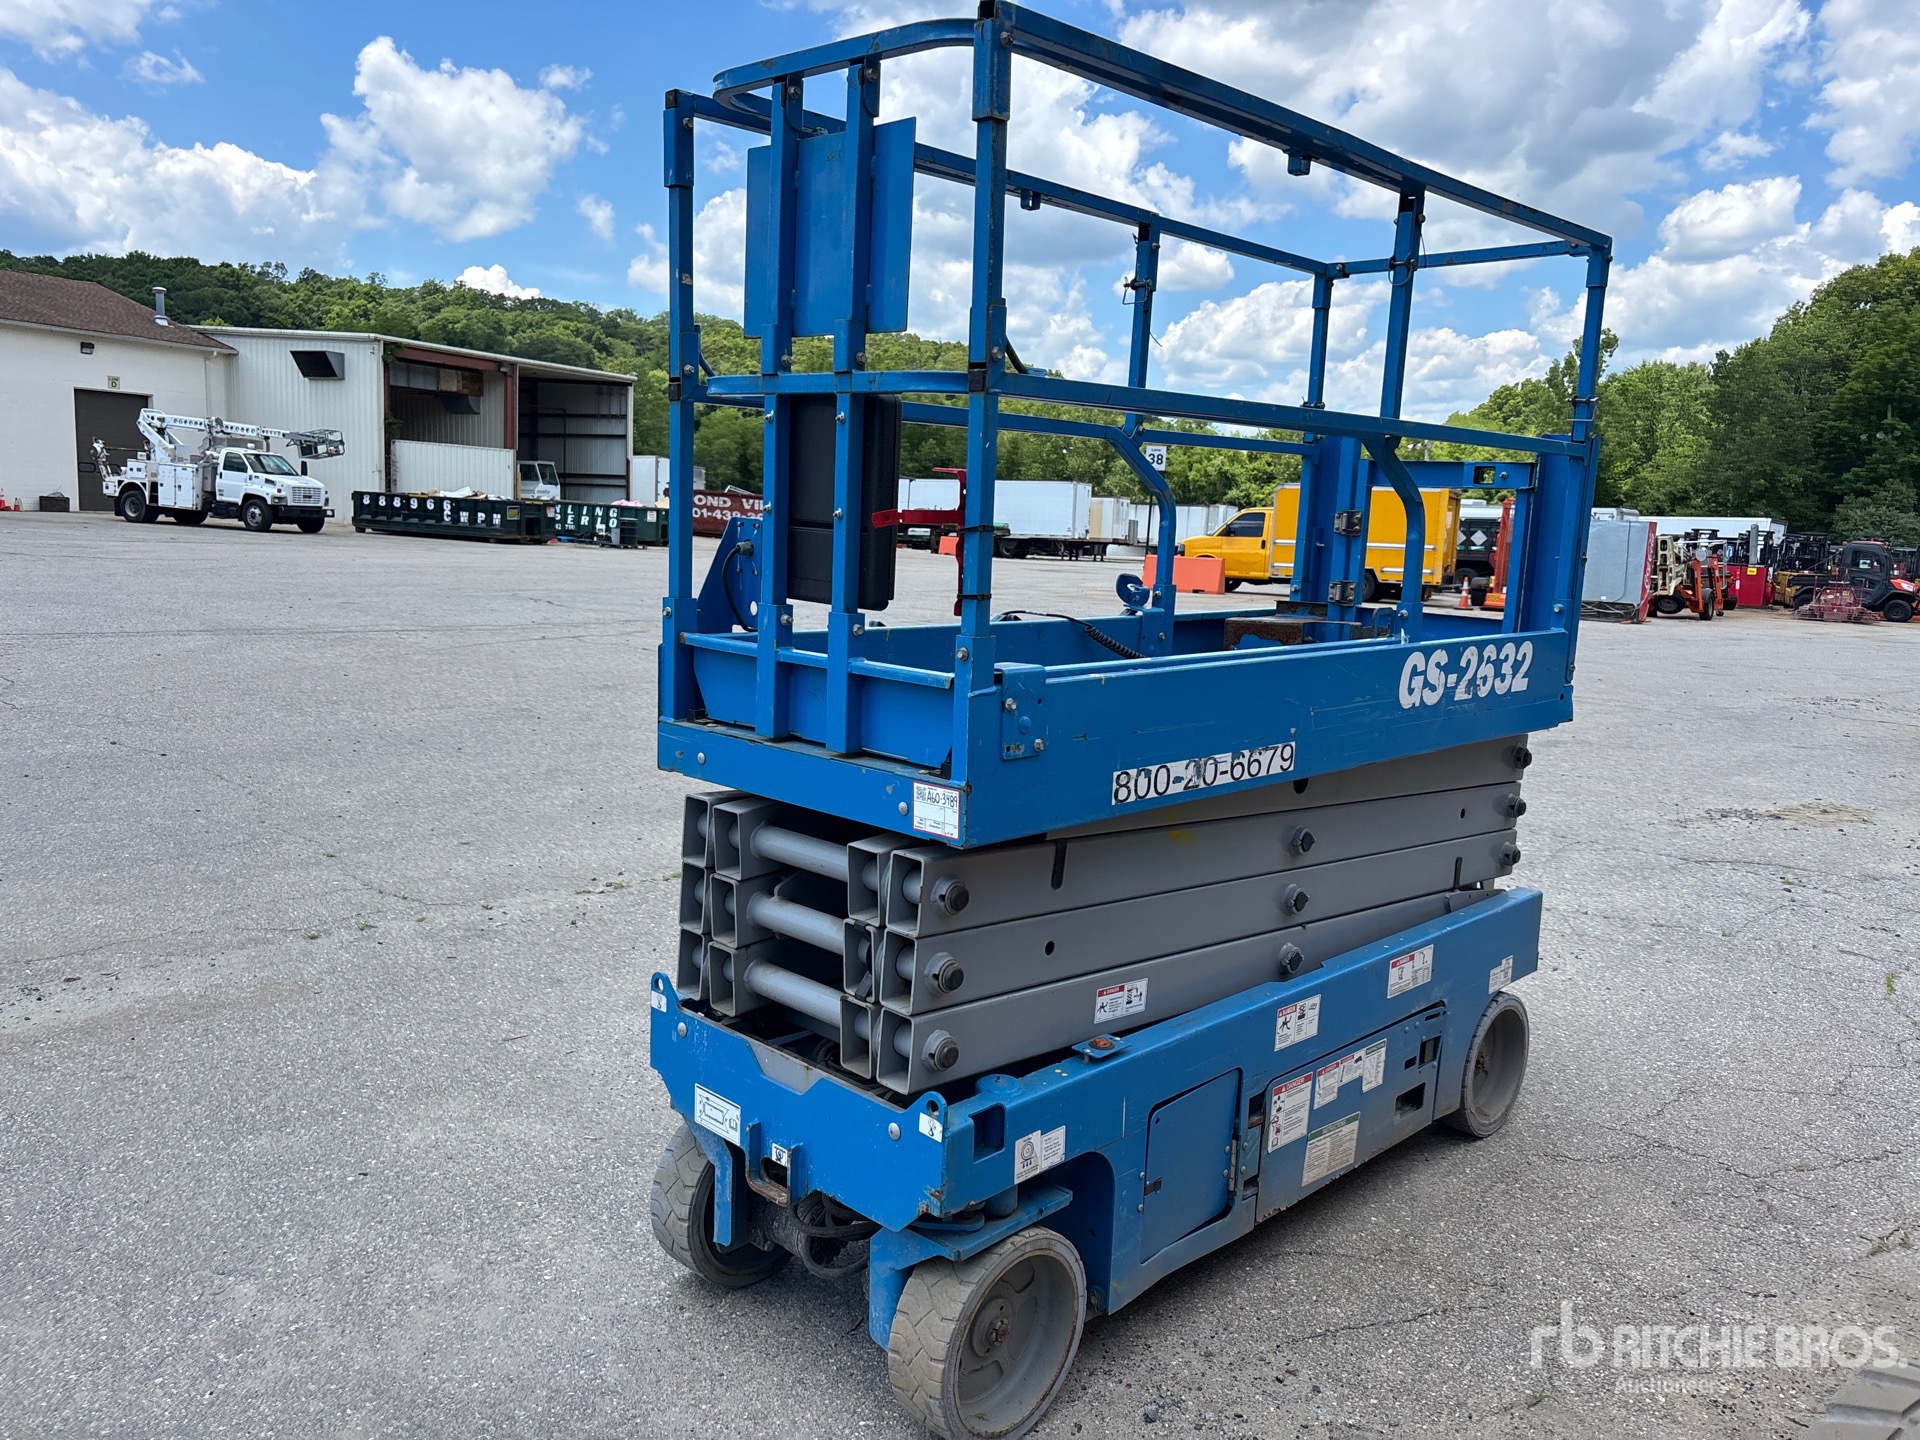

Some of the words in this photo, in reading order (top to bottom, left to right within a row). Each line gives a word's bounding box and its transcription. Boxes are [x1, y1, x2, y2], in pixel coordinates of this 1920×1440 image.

[1148, 453, 1164, 465] 38
[693, 494, 732, 508] OND
[1399, 641, 1533, 709] GS-2632
[1113, 743, 1293, 803] 800-20-6679
